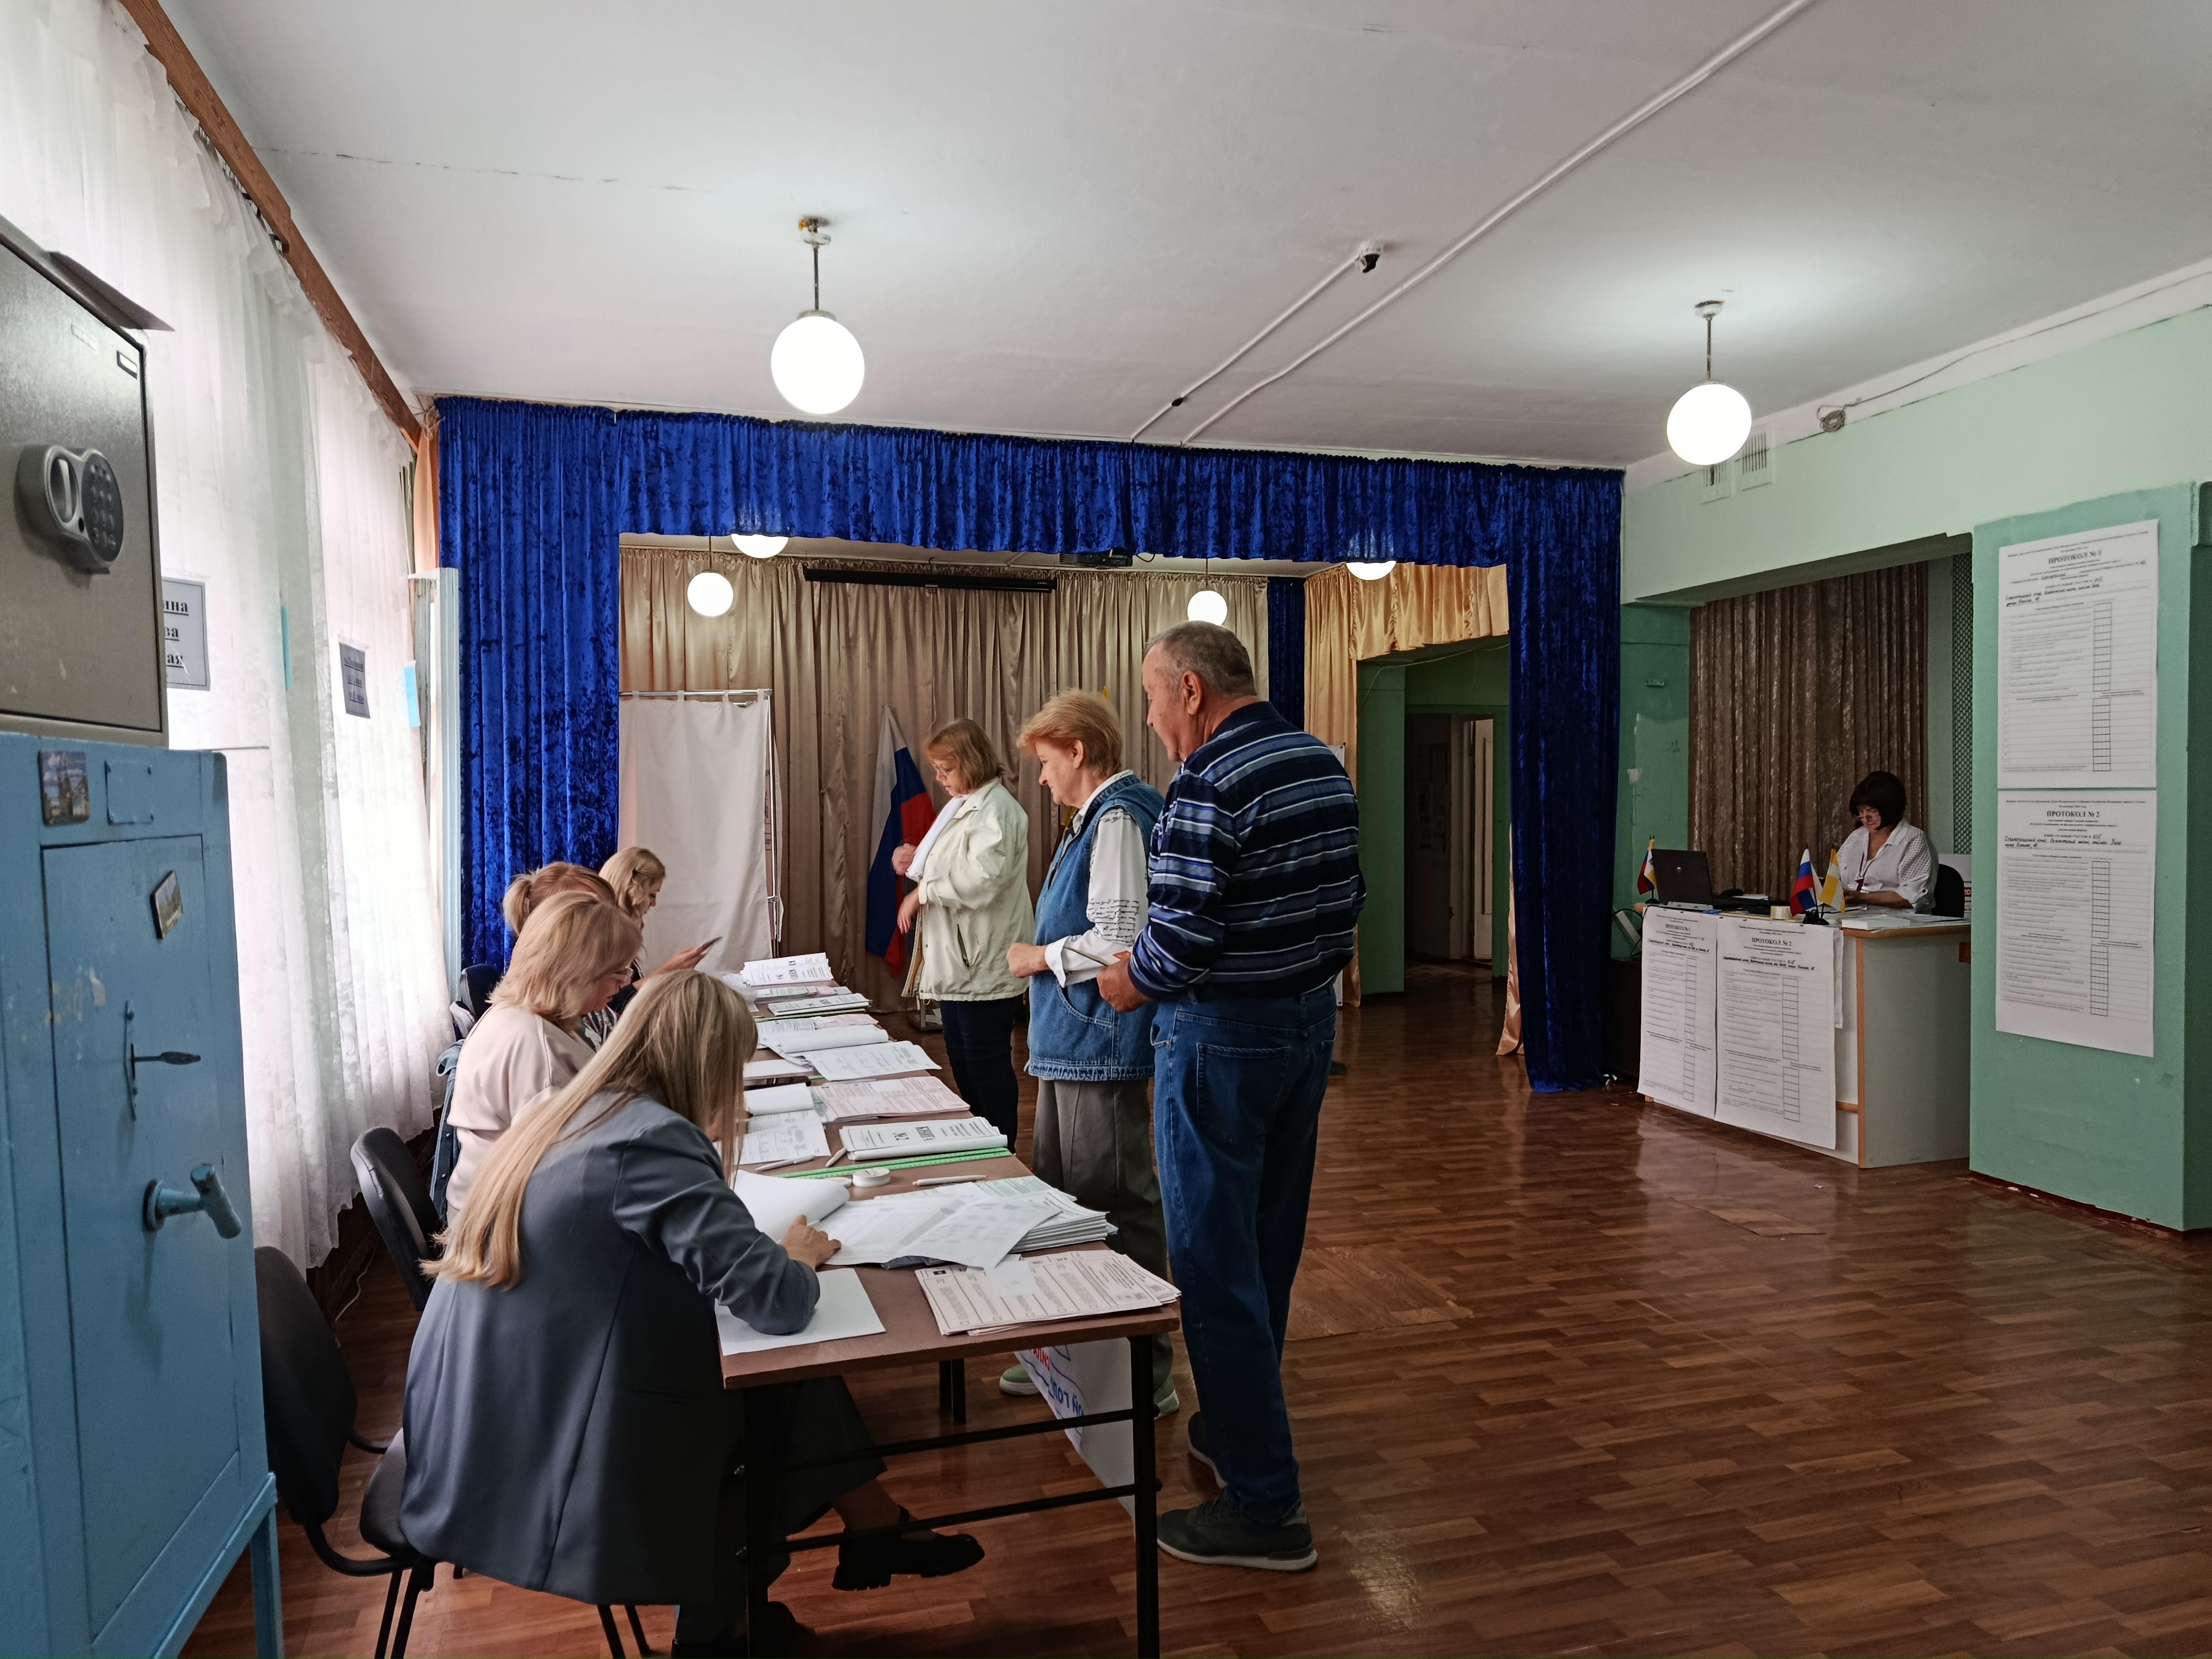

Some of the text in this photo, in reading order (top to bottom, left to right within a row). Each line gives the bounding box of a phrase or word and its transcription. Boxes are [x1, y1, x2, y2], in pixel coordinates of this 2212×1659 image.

[2048, 552, 2088, 564] ПРОТОКОЛ
[1752, 937, 1781, 946] ПРОТОКОЛ
[916, 1126, 936, 1141] КНИГА
